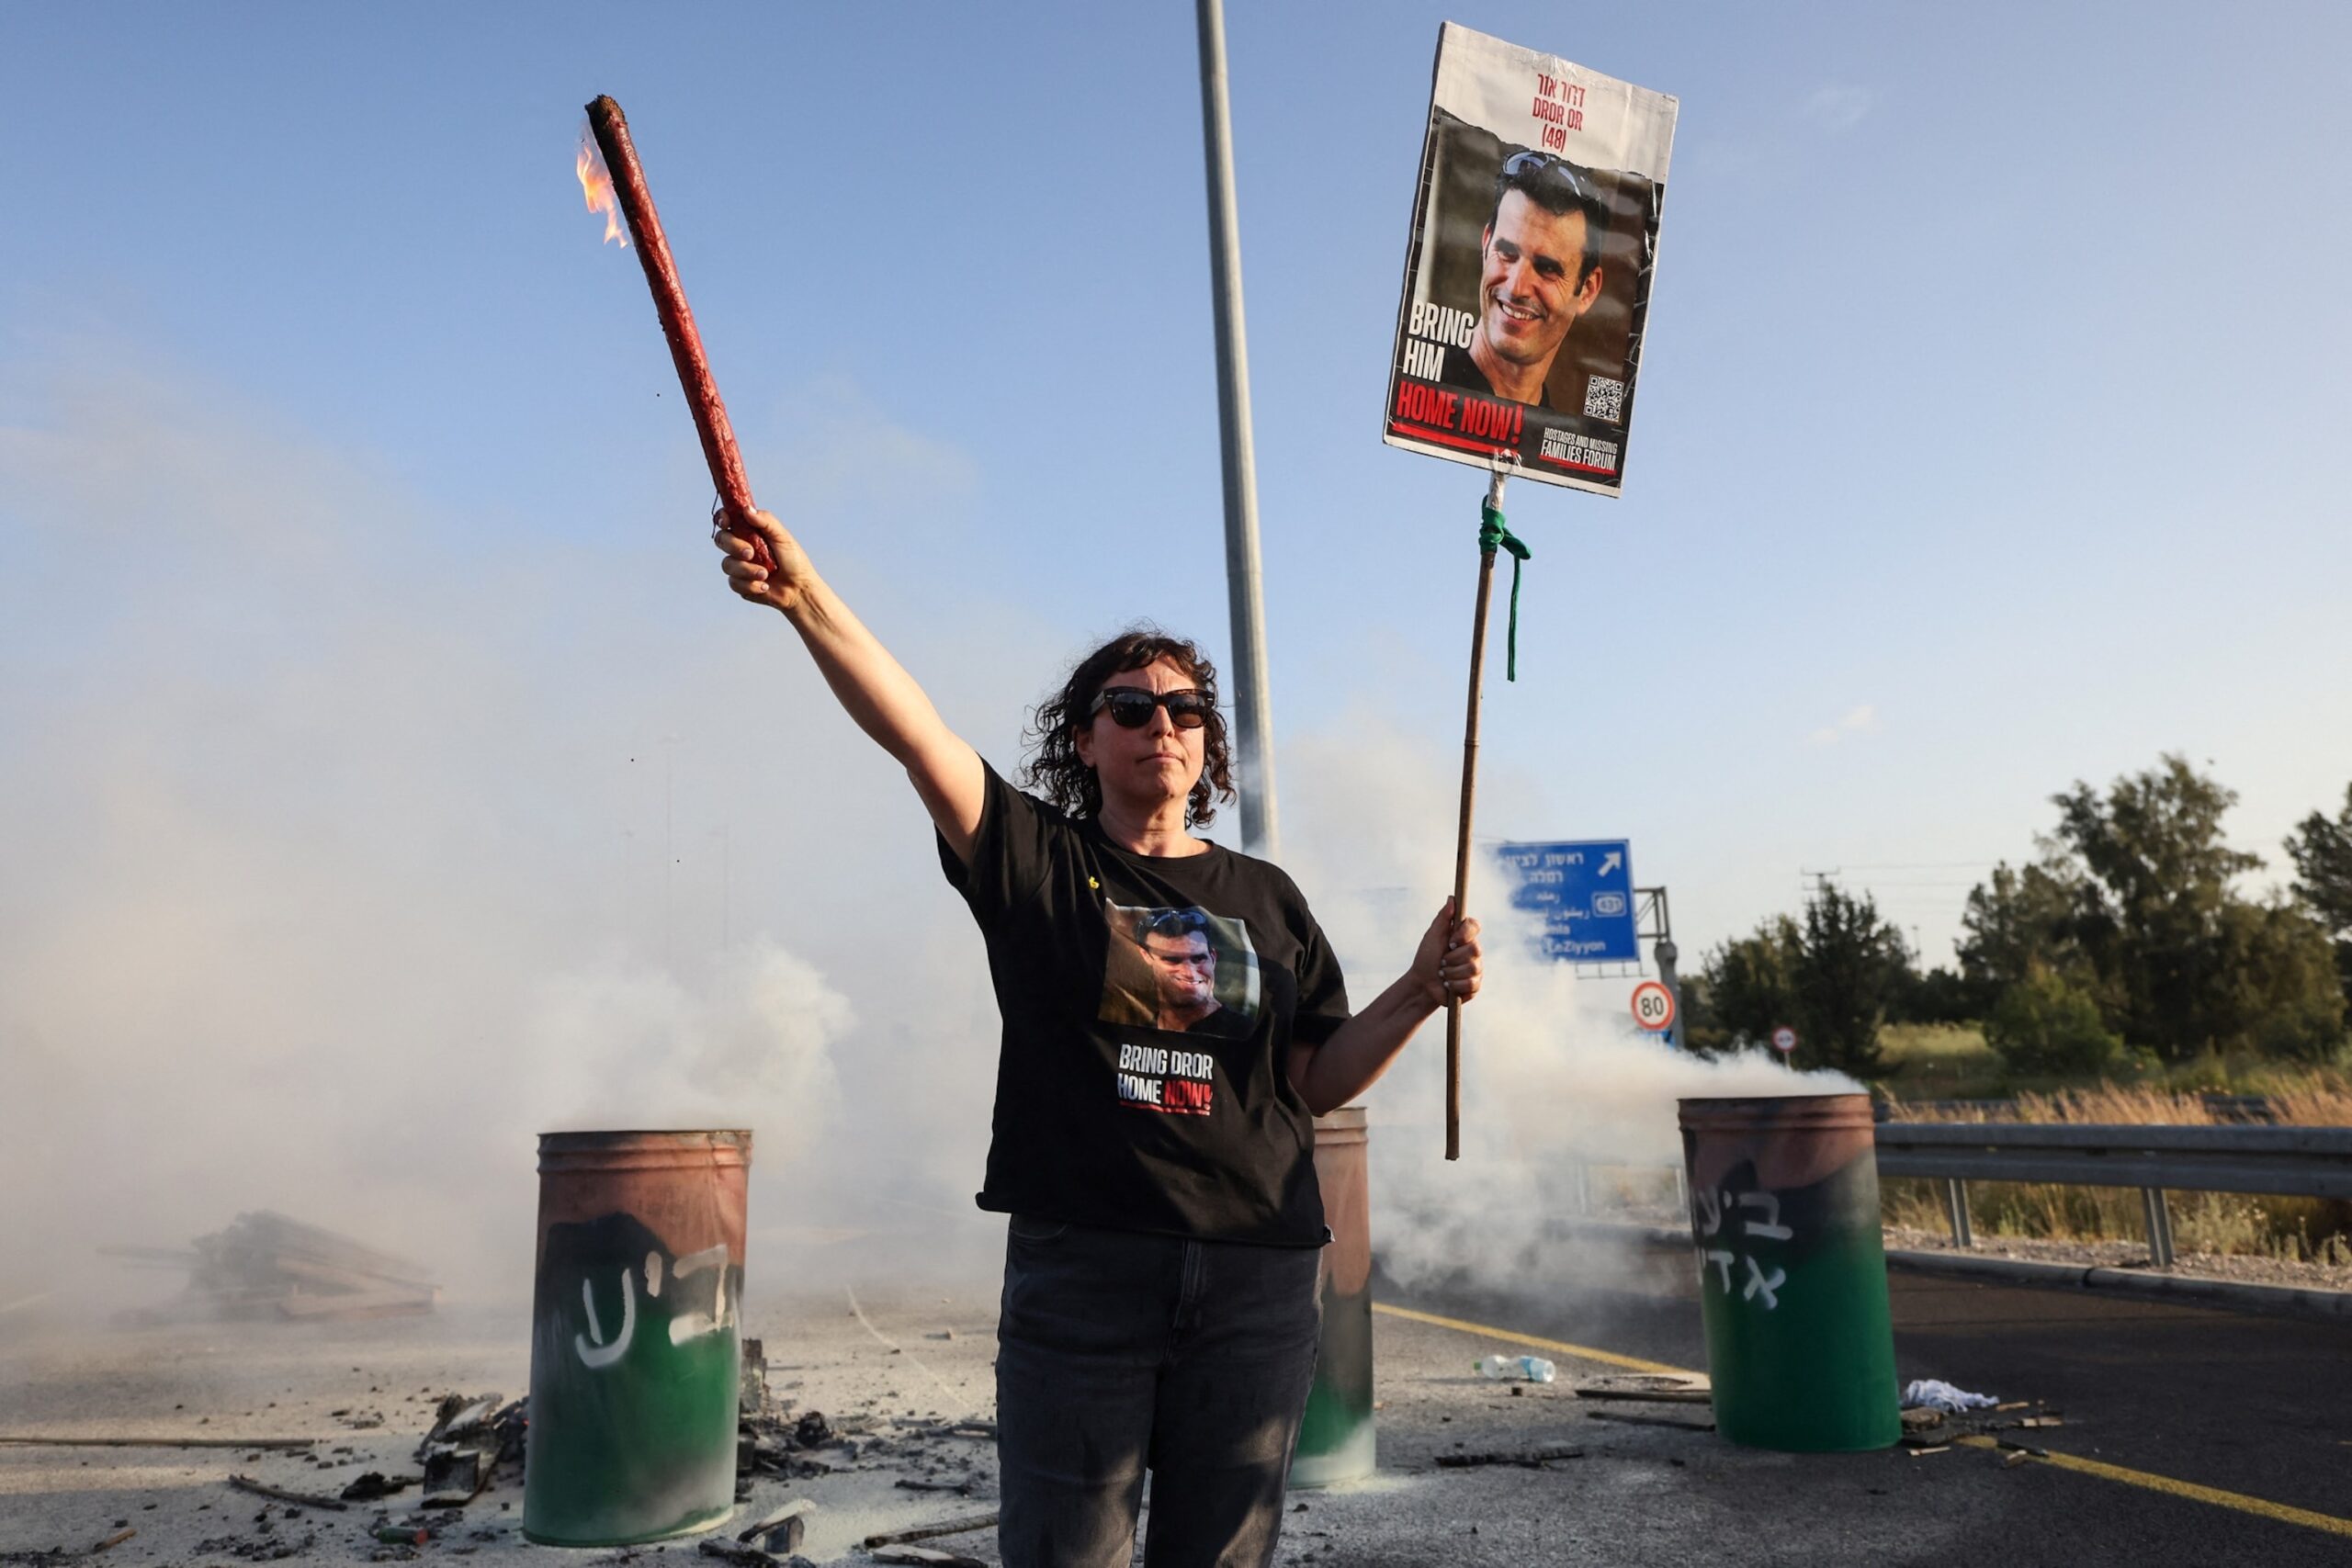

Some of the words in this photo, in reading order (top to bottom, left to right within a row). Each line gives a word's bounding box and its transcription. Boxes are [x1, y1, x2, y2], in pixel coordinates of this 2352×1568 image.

[1537, 73, 1558, 98] אור
[1561, 81, 1586, 107] דרור
[1532, 96, 1565, 125] DROR
[1566, 108, 1583, 131] OR
[1542, 123, 1566, 153] (48)
[1408, 299, 1475, 349] BRING
[1402, 337, 1445, 382] HIM
[1396, 381, 1458, 430] HOME
[1460, 397, 1524, 445] NOW!
[1540, 439, 1581, 464] FAMILIES
[1582, 449, 1616, 471] FORUM
[1544, 426, 1576, 446] HOSTAGES
[1575, 435, 1589, 448] AND
[1589, 437, 1618, 455] MISSING
[1545, 852, 1584, 866] ראשון
[1641, 997, 1664, 1017] 80
[1119, 1043, 1168, 1075] BRING
[1170, 1050, 1213, 1080] DROR
[1117, 1073, 1162, 1104] HOME
[1164, 1080, 1213, 1111] NOW!
